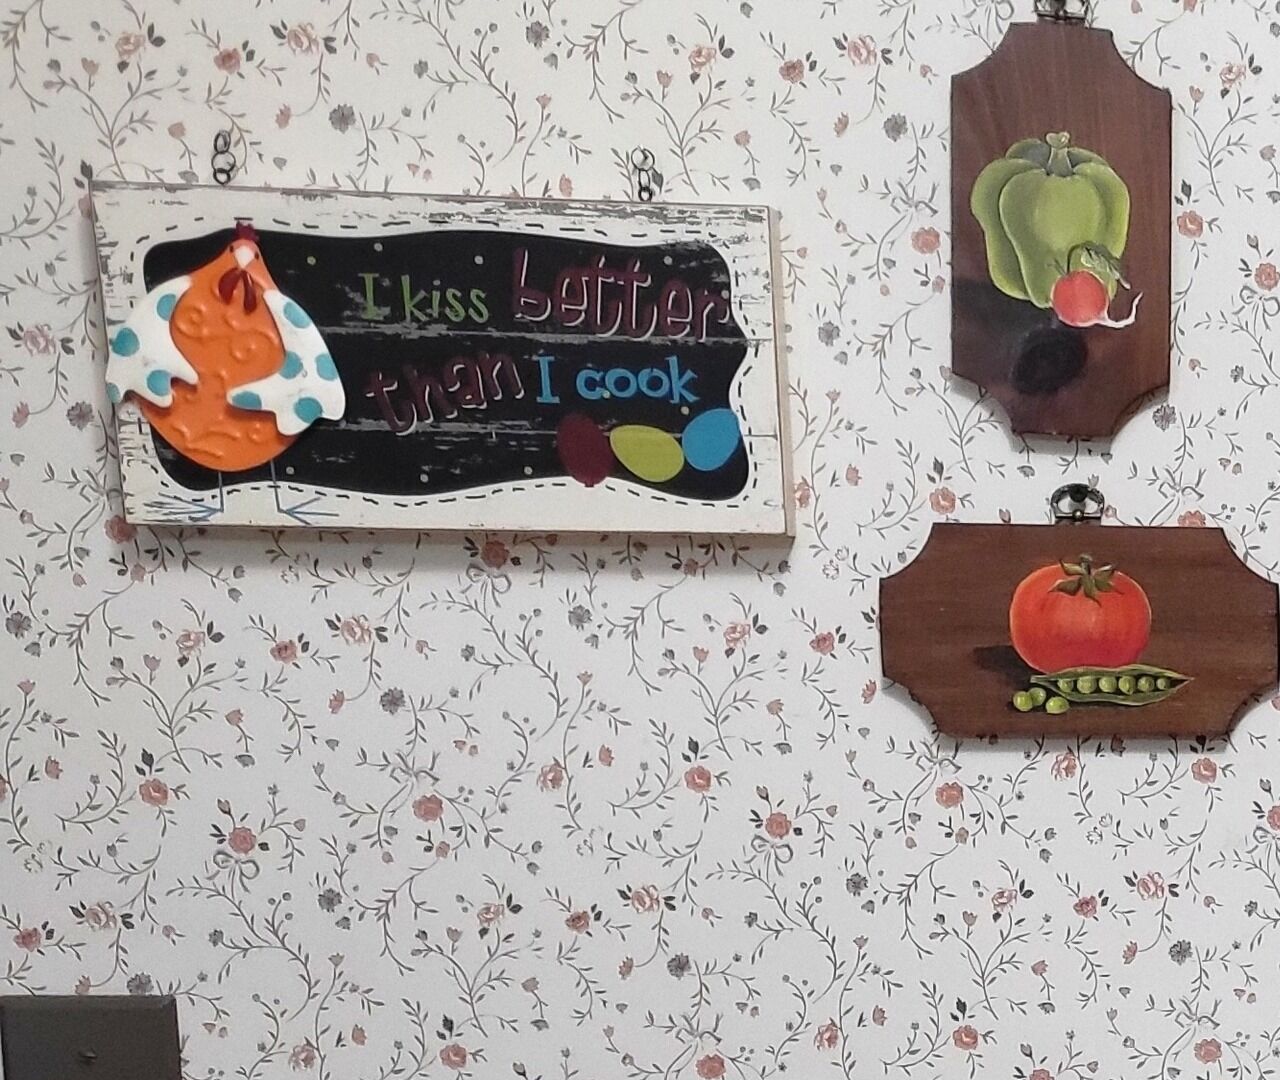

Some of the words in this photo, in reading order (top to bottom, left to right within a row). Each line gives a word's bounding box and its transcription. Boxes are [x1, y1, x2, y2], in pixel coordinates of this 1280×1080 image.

[357, 273, 386, 321] I
[401, 274, 489, 324] kiss
[513, 247, 731, 343] better
[365, 352, 525, 436] than
[532, 355, 561, 404] I
[576, 354, 699, 405] cook
